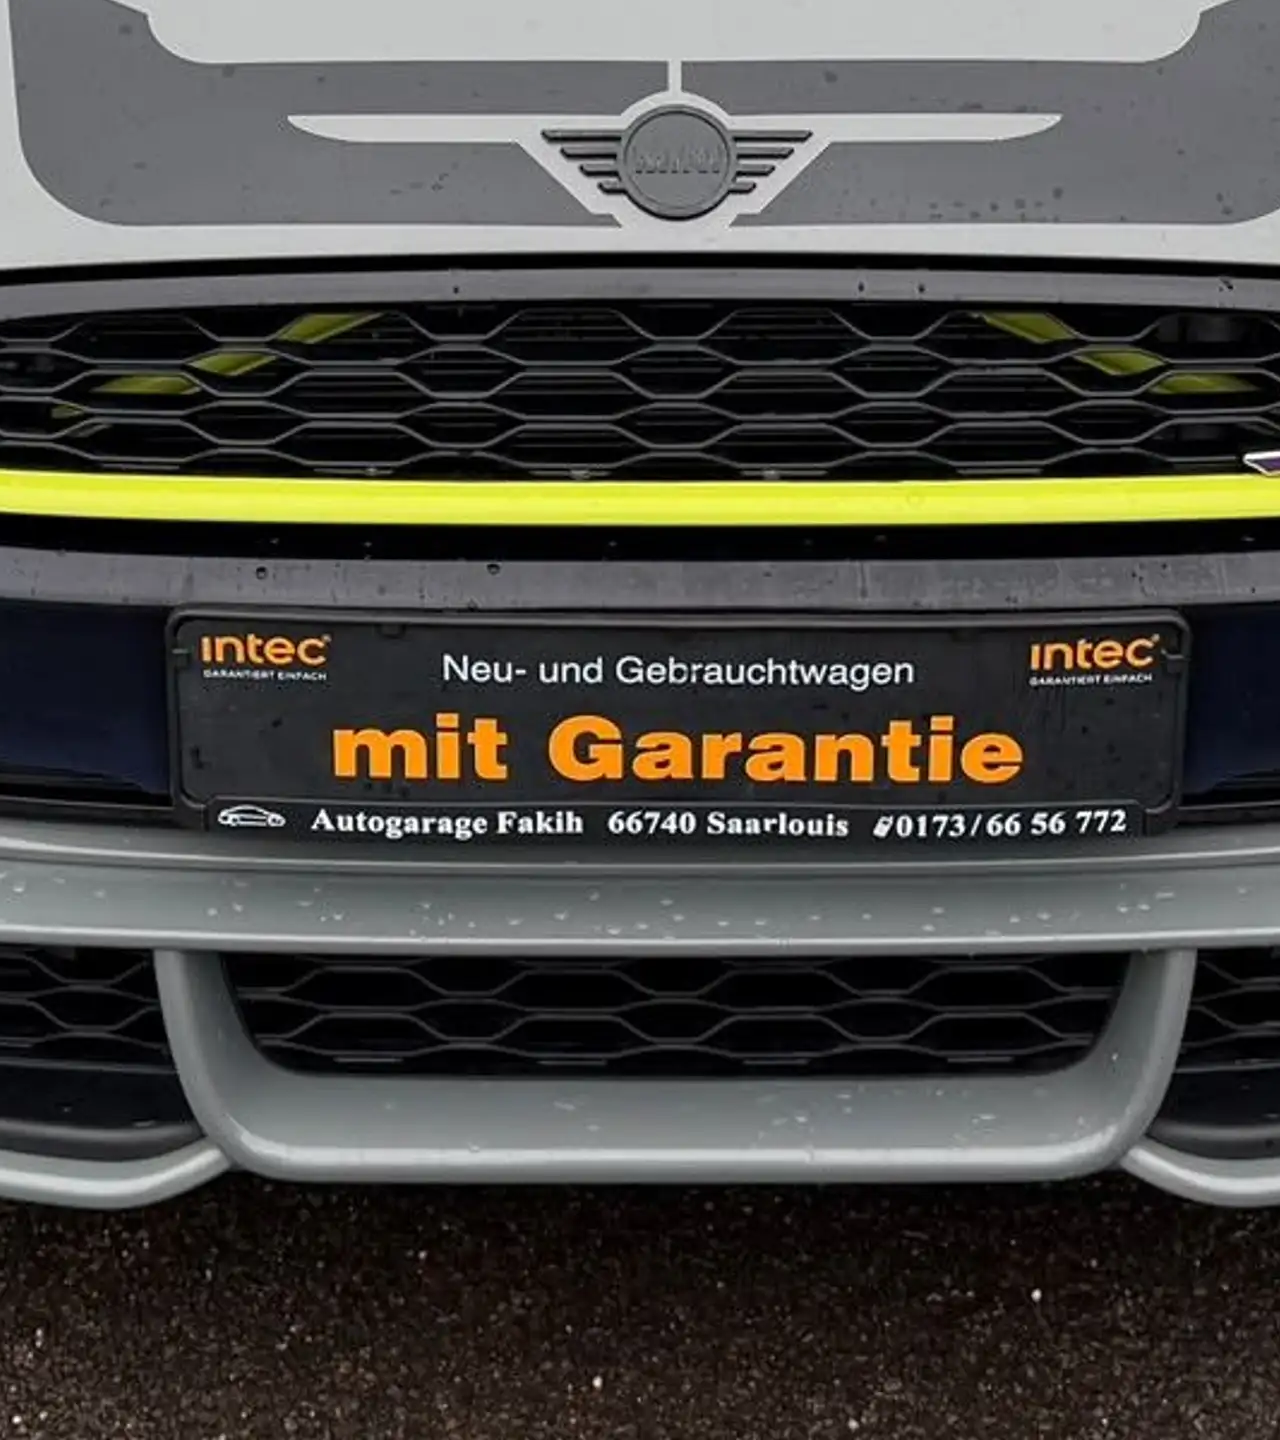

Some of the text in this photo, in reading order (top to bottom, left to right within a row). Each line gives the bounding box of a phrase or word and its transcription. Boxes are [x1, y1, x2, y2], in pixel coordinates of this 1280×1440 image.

[443, 653, 915, 692] Neu- und Gebrauchtwagen
[333, 712, 1024, 783] mit Garantie
[310, 808, 488, 841] Autogarage
[497, 810, 584, 835] Fakih
[607, 810, 697, 835] 66740
[706, 811, 849, 838] Saarlouis
[1030, 811, 1066, 836] 56
[1075, 808, 1127, 835] 772
